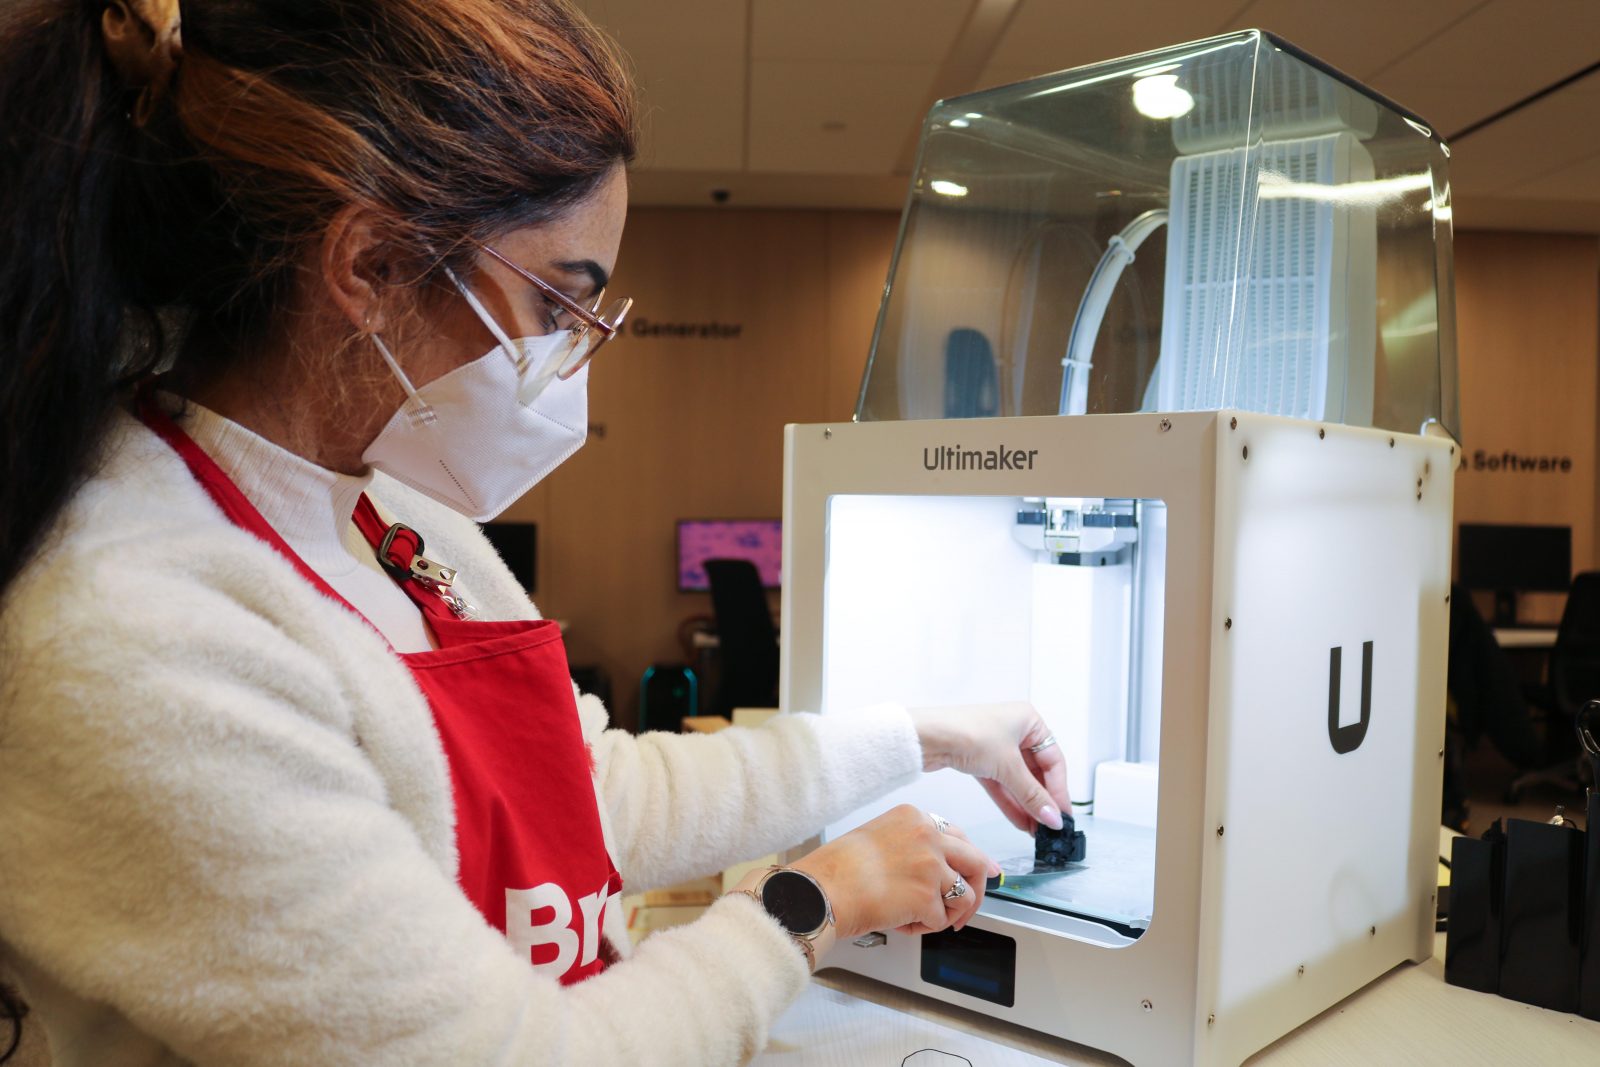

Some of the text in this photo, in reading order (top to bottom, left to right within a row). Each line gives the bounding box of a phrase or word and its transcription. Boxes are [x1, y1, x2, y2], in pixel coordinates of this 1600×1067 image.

[632, 318, 742, 338] Generator
[924, 444, 1038, 471] Ultimaker
[1473, 450, 1572, 472] Software
[1327, 640, 1374, 755] U
